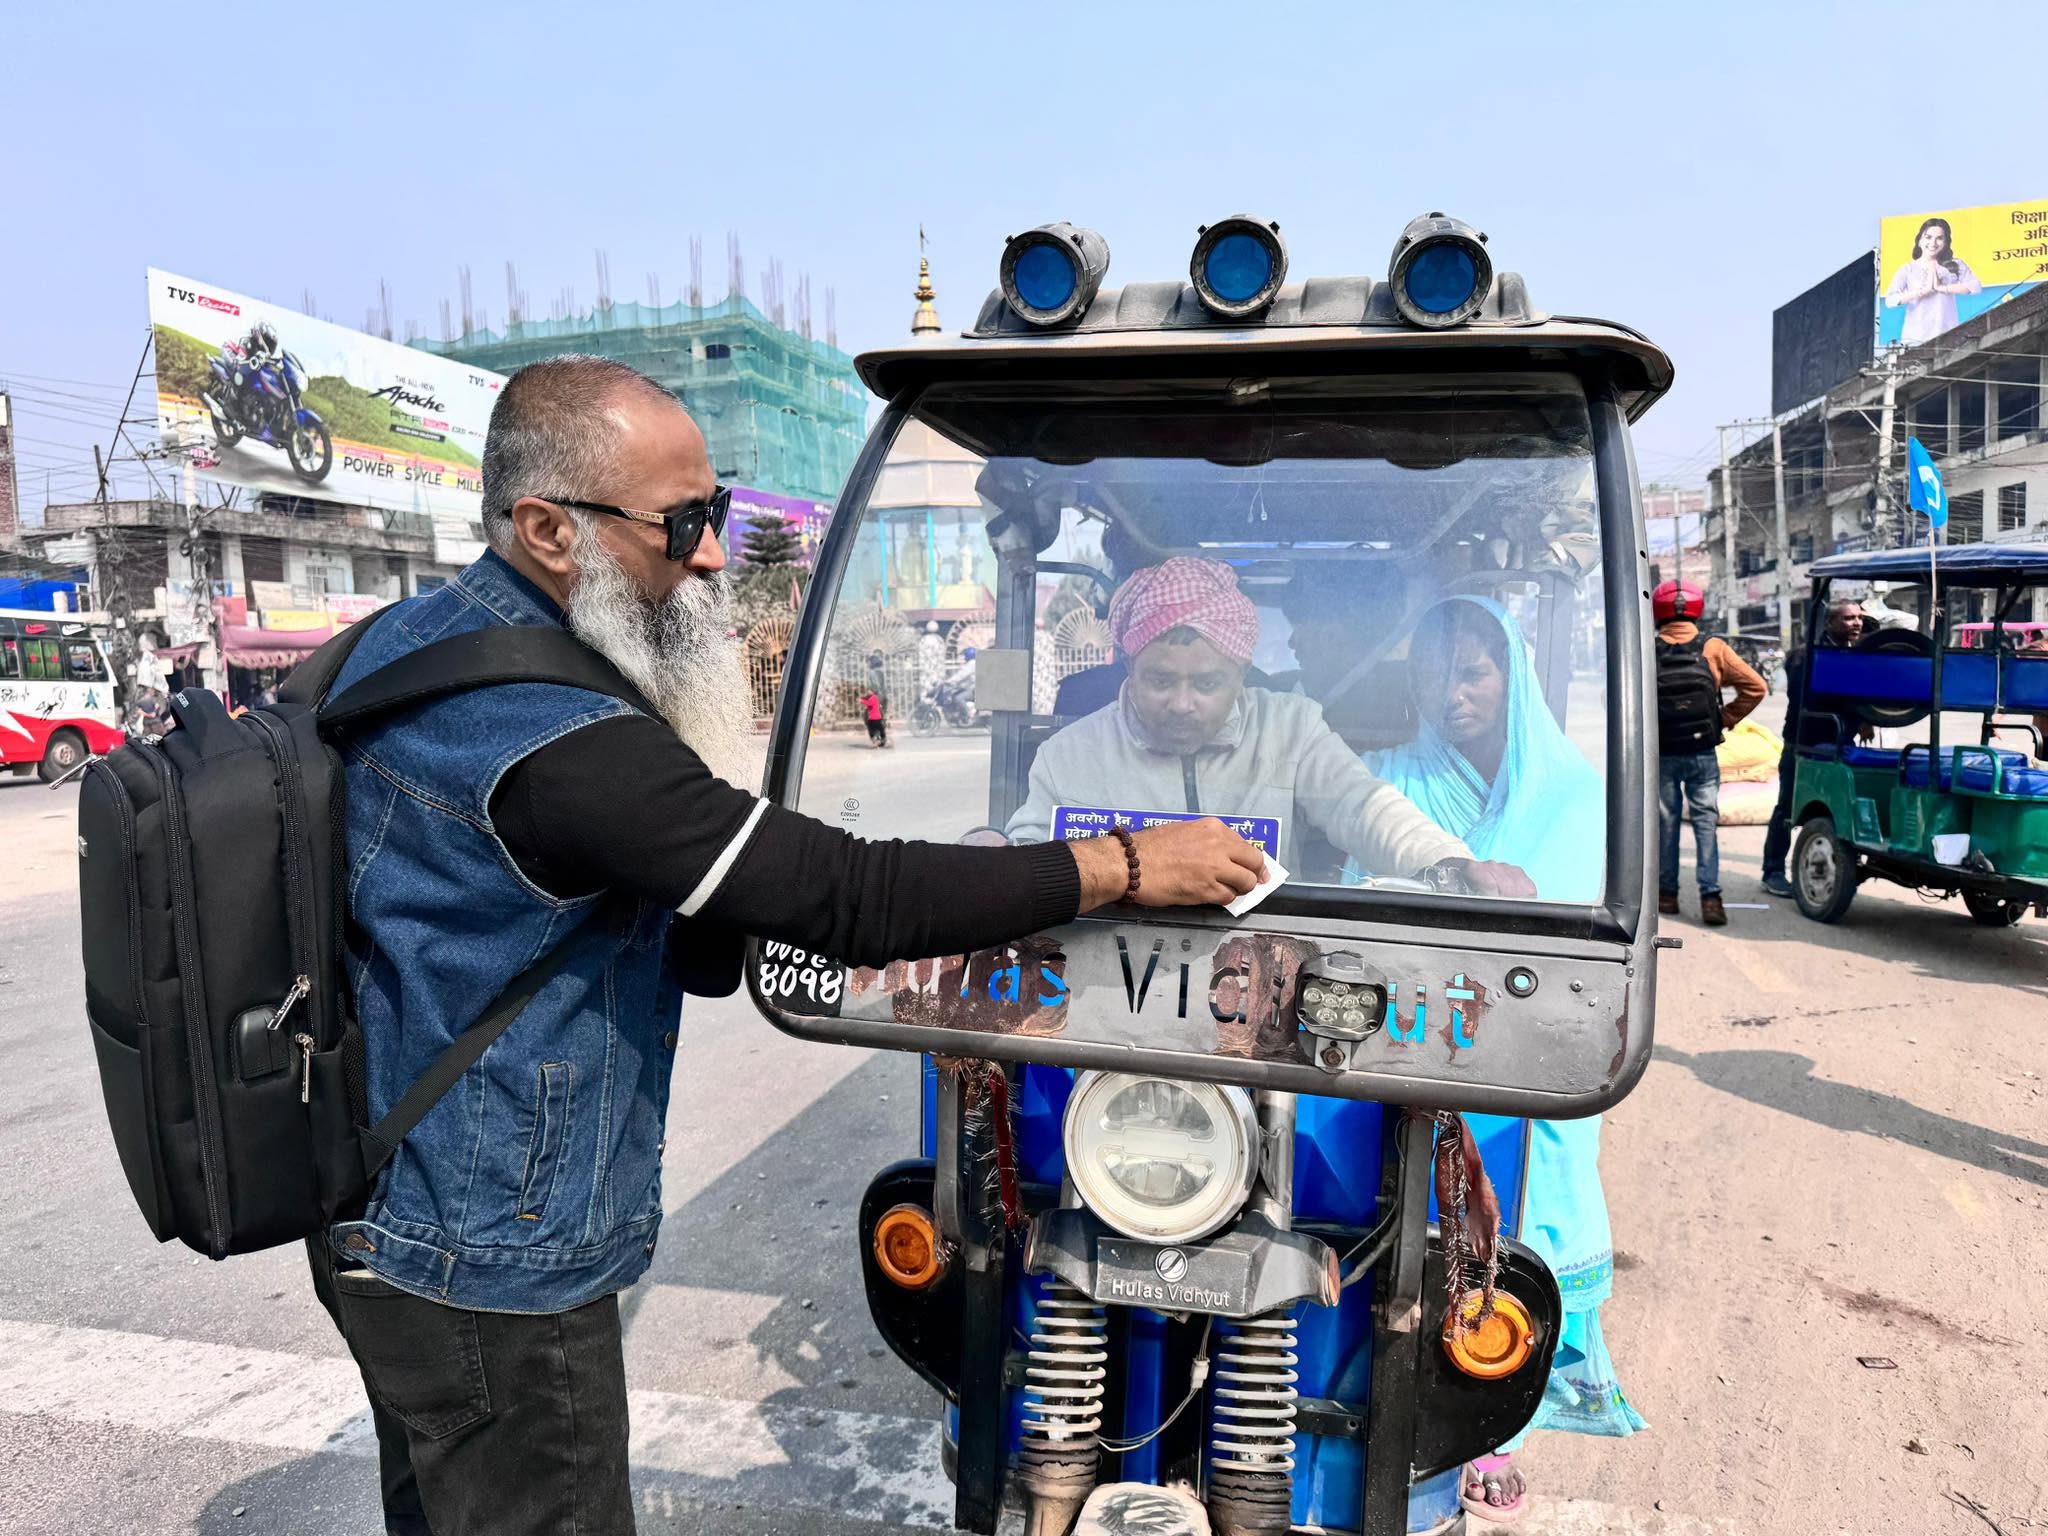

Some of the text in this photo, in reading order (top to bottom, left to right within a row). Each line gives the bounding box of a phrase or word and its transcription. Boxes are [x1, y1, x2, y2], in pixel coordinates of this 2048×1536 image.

[167, 286, 196, 304] TVS
[468, 375, 485, 387] TVS
[368, 385, 446, 413] Apache
[344, 456, 394, 478] POWER
[1065, 812, 1109, 825] अवरोध
[1065, 826, 1092, 839] प्रदेश
[759, 964, 844, 1004] 8098
[1111, 1279, 1231, 1308] Hulas Vidhyut
